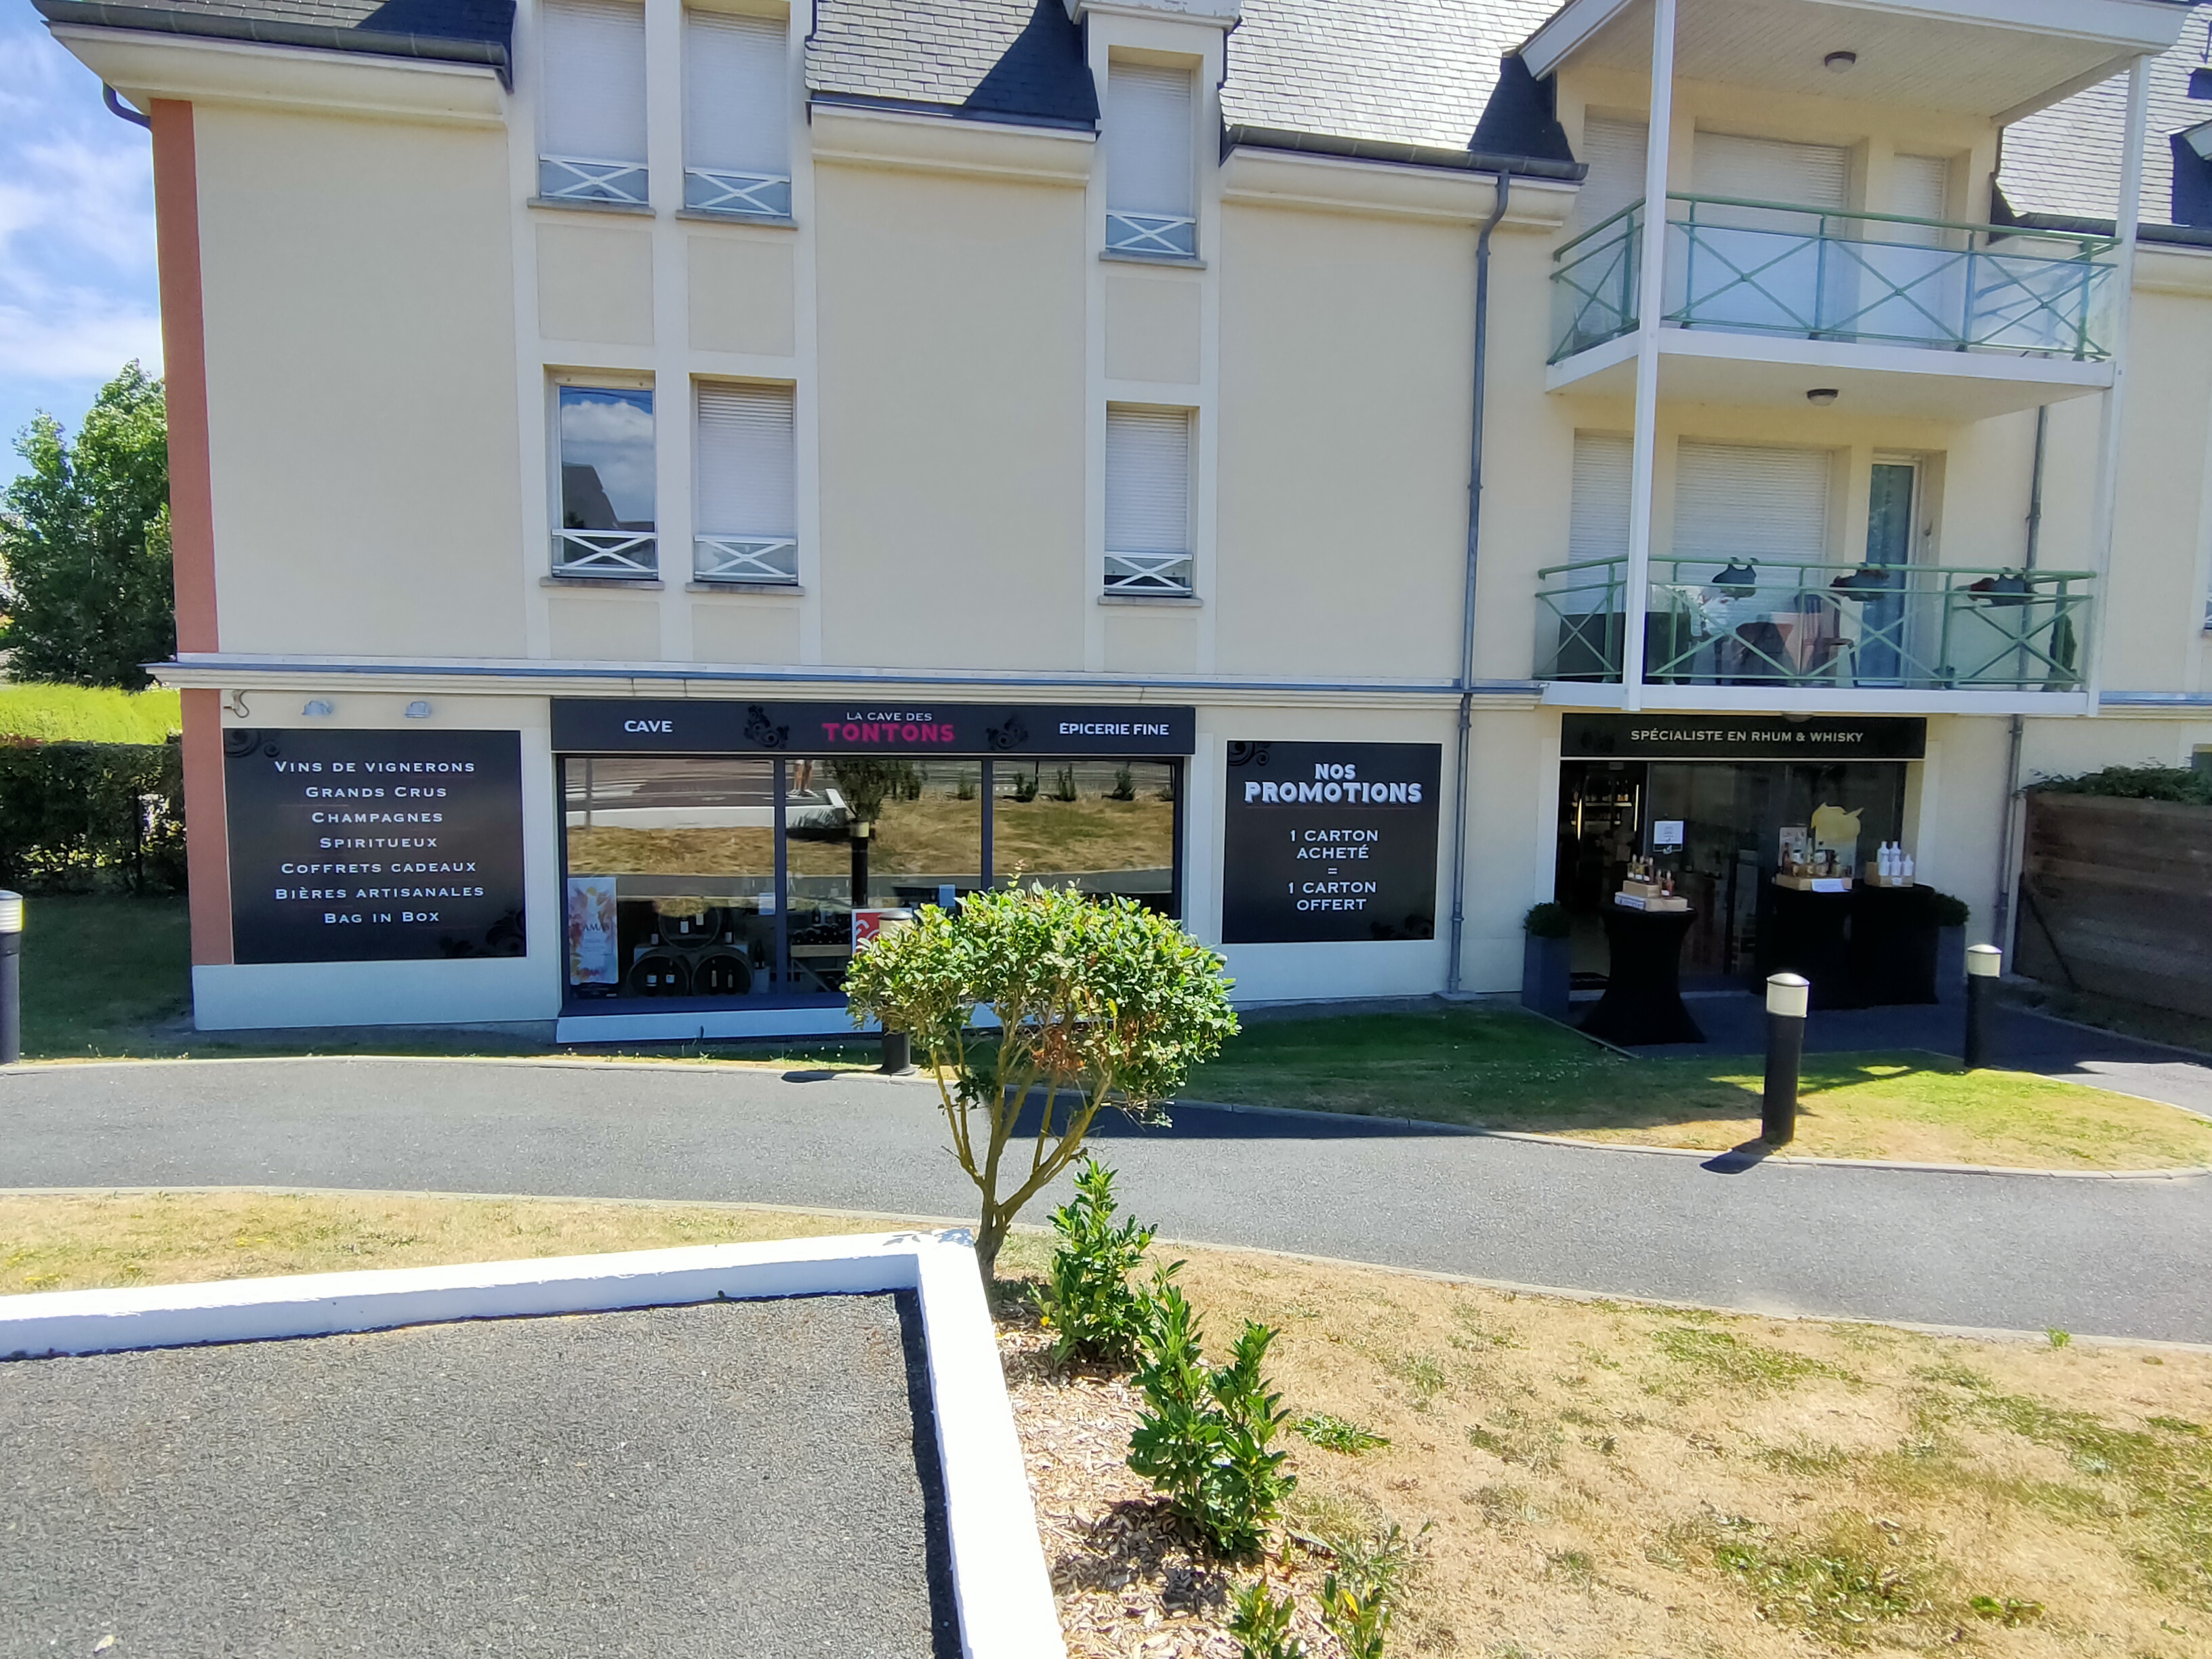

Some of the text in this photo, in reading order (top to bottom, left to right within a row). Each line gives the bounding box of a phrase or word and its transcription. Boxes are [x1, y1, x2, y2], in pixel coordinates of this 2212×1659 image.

[846, 712, 933, 721] LA CAVE DES
[624, 720, 673, 733] CAVE
[822, 722, 954, 743] TONTONS
[1059, 722, 1169, 735] ÉPICERIE FINE
[1631, 727, 1864, 742] SPÉCIALISTE EN RHUM & WHISKY
[274, 761, 474, 773] VINS DE VIGNERONS
[1314, 763, 1356, 780] NOS
[306, 786, 447, 798] GRANDS CRUS
[1244, 781, 1422, 804] PROMOTIONS
[312, 812, 443, 823] CHAMPAGNES
[1290, 830, 1378, 842] 1 CARTON
[320, 838, 437, 848] SPIRITUEUX
[1296, 844, 1369, 859] ACHETÉ
[281, 862, 476, 874] COFFRETS CADEAUX
[275, 886, 484, 899] BIÈRES ARTISANALES
[1288, 881, 1376, 894] 1 CARTON
[1296, 899, 1367, 911] OFFERT
[324, 912, 439, 924] BAG IN BOX
